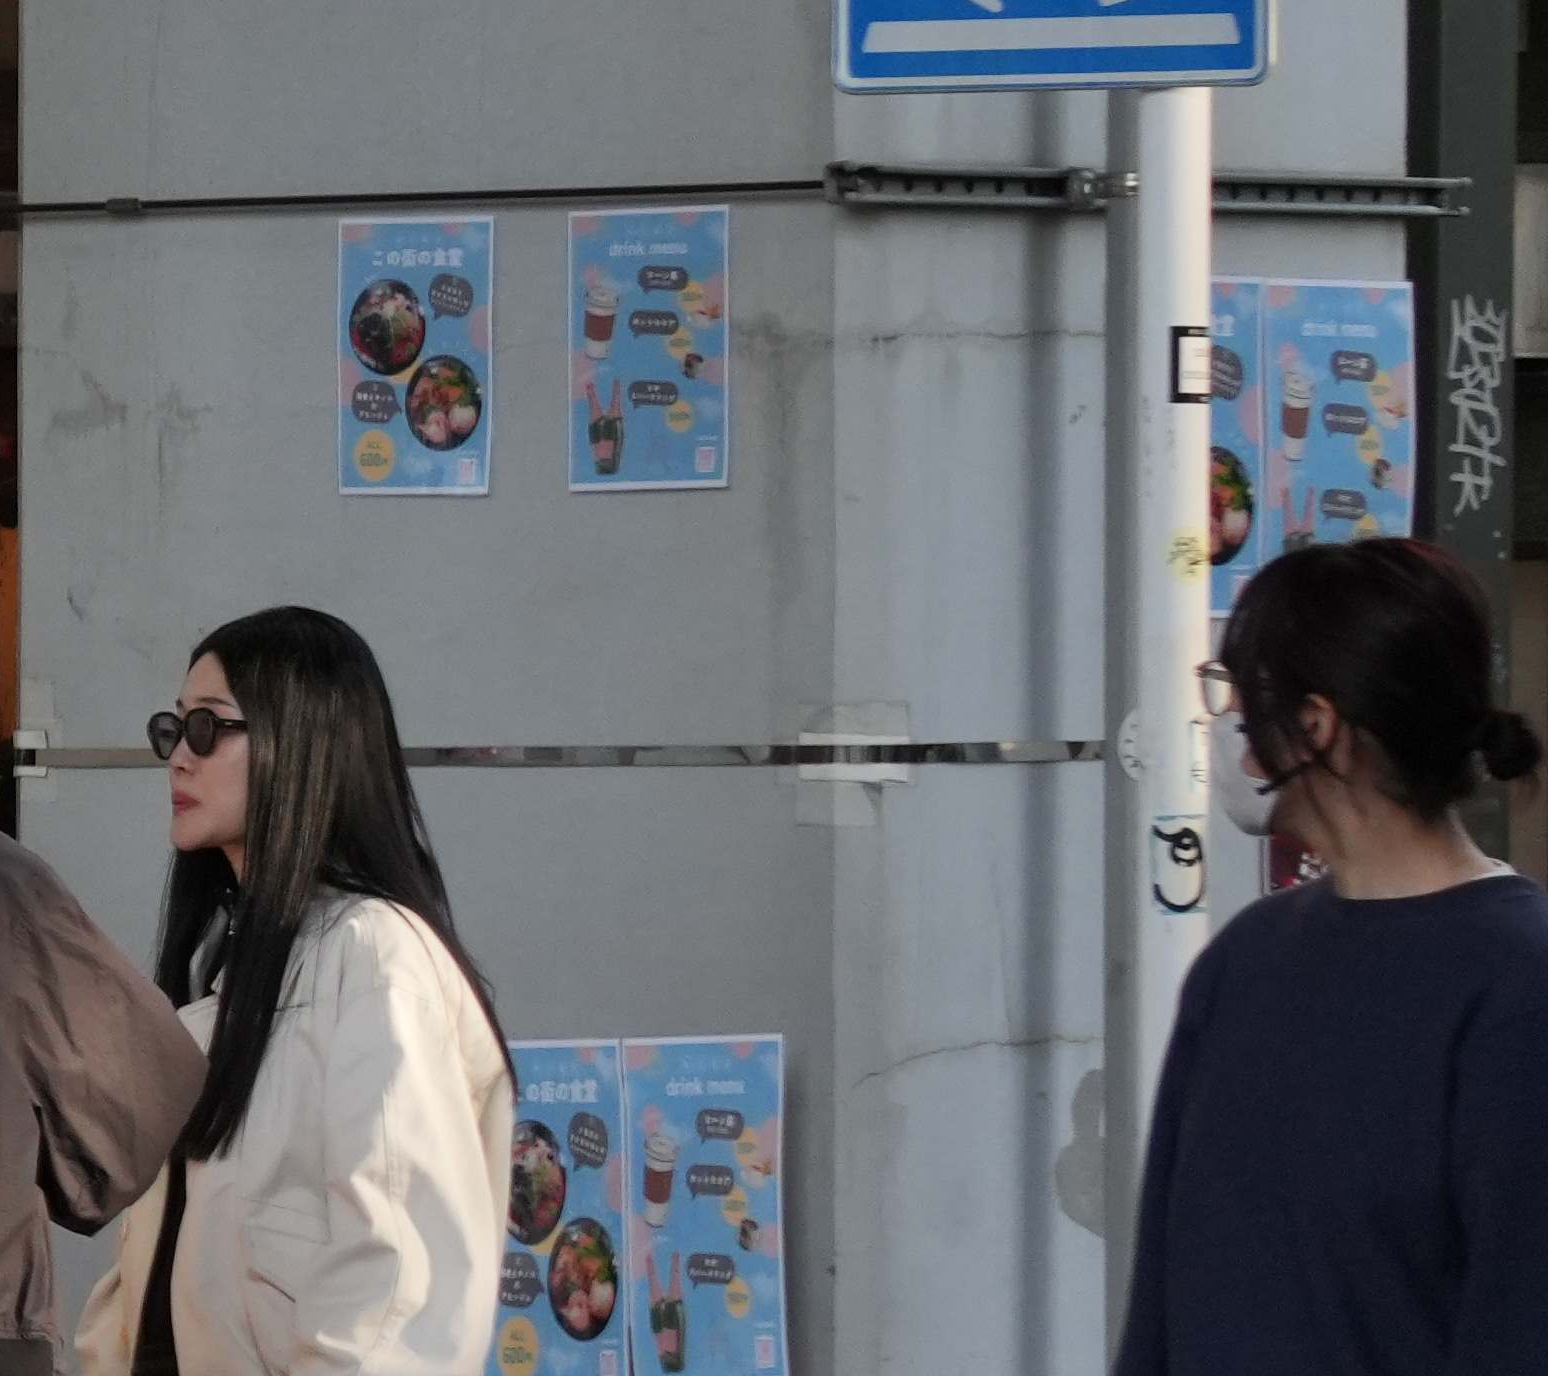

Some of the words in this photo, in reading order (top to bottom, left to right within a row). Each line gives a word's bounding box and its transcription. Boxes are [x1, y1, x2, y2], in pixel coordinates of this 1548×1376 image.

[517, 1078, 598, 1103] の街の食堂
